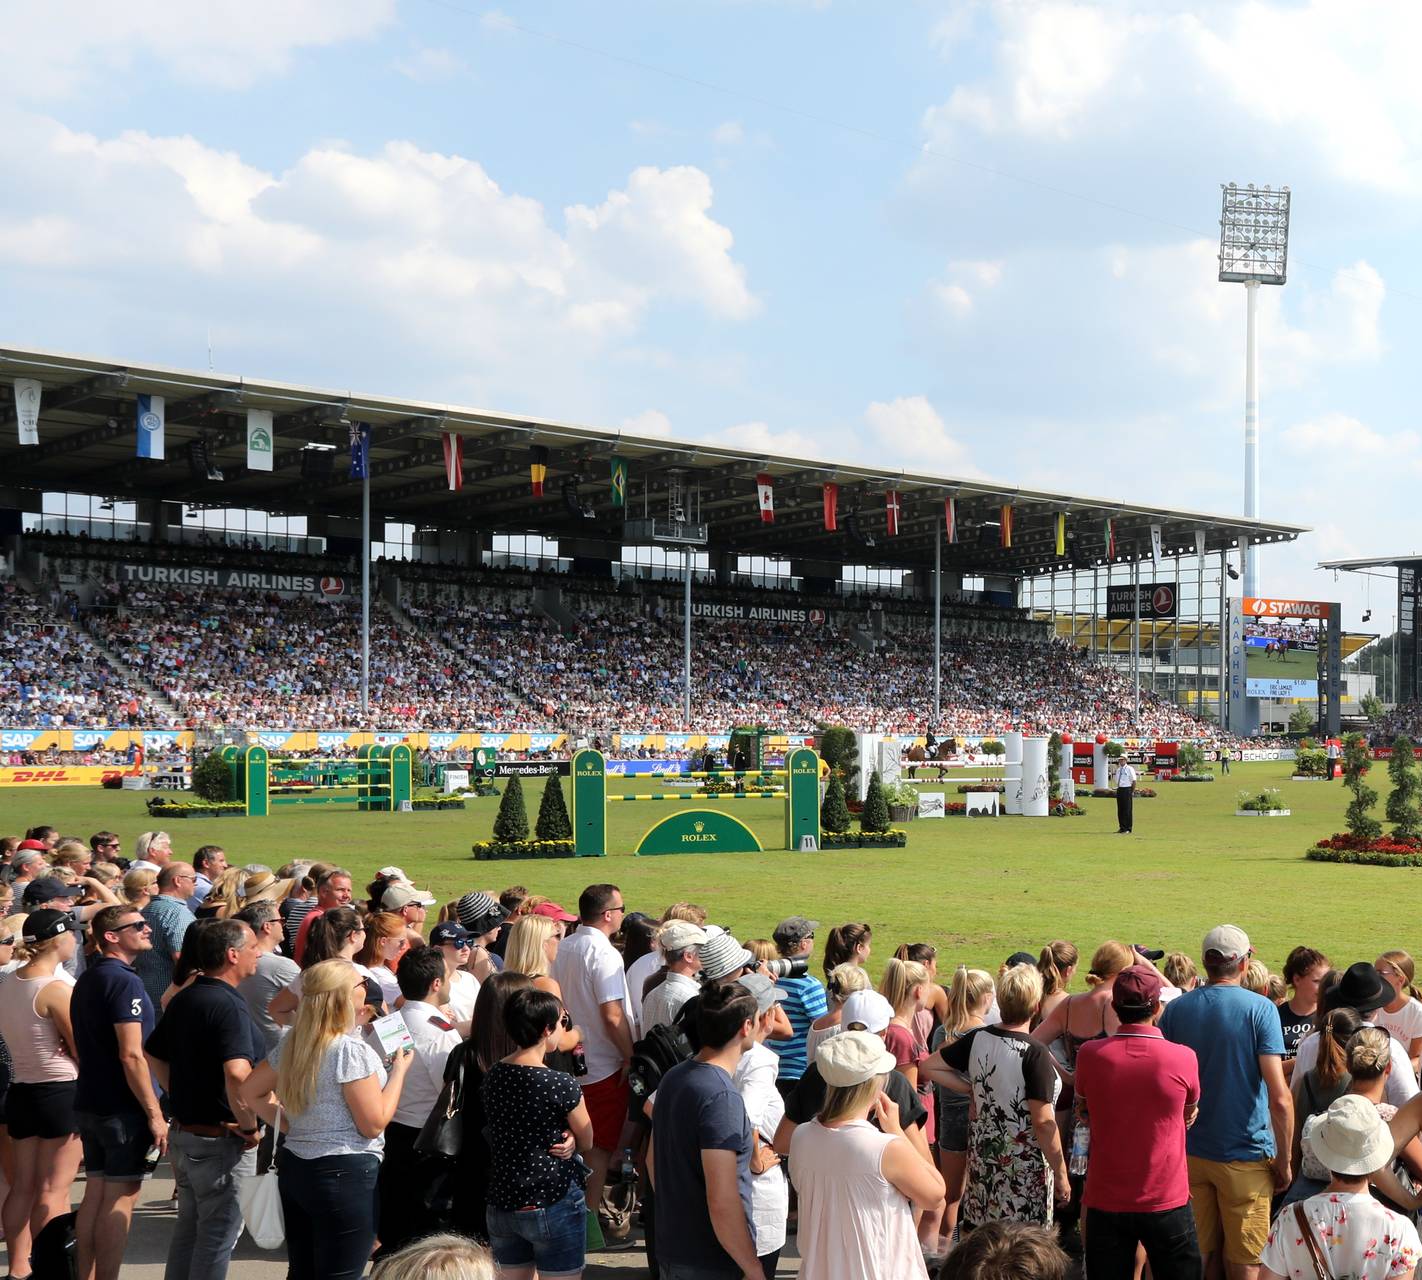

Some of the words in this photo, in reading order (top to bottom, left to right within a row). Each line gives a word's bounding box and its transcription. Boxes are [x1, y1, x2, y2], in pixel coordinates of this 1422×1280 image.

[124, 565, 218, 585] TURKISH
[227, 572, 315, 592] AIRLINES
[1110, 590, 1151, 601] TURKSH
[687, 603, 743, 618] URKISH
[749, 607, 806, 622] AIRLINES
[1110, 602, 1151, 613] AIRLIES
[1269, 602, 1320, 616] STAWAG
[1, 733, 34, 747] SAP
[318, 735, 344, 747] SAP
[429, 736, 453, 748] SAP
[481, 736, 504, 748] SAP
[531, 736, 553, 748] SAP
[621, 737, 642, 747] SAP
[666, 737, 685, 747] SAP
[708, 737, 729, 747] SAP
[651, 763, 675, 773] Lindt
[12, 771, 69, 782] DHL
[682, 834, 717, 842] ROLEX
[804, 837, 813, 848] 11
[131, 998, 142, 1016] 3
[1283, 1023, 1315, 1036] POO
